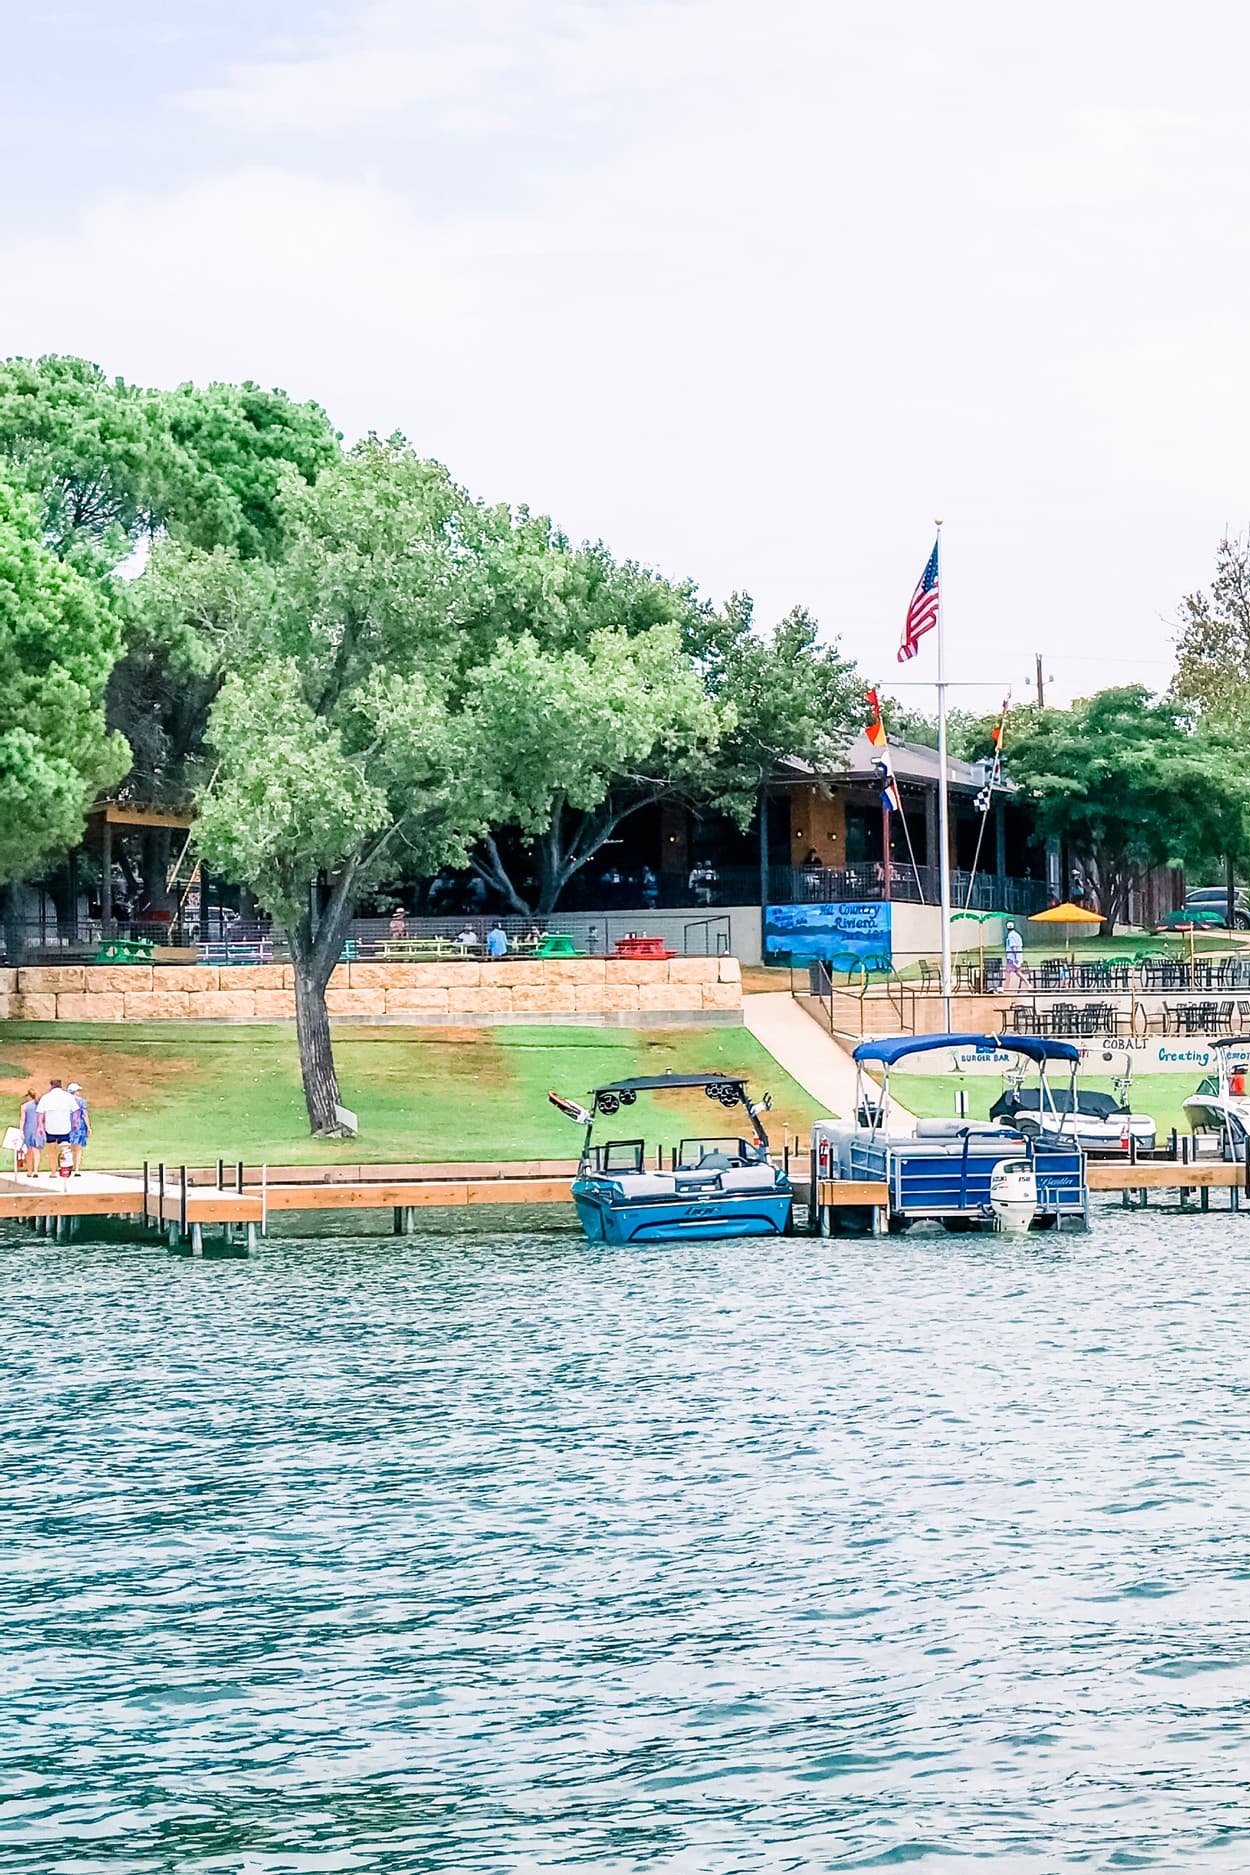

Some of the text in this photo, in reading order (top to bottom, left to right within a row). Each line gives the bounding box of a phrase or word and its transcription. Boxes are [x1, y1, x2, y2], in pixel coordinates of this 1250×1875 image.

[838, 904, 882, 919] Country
[834, 917, 878, 929] Riviera
[1103, 1038, 1149, 1050] COBALT
[993, 1054, 1010, 1062] BAR
[1158, 1047, 1209, 1066] Creating
